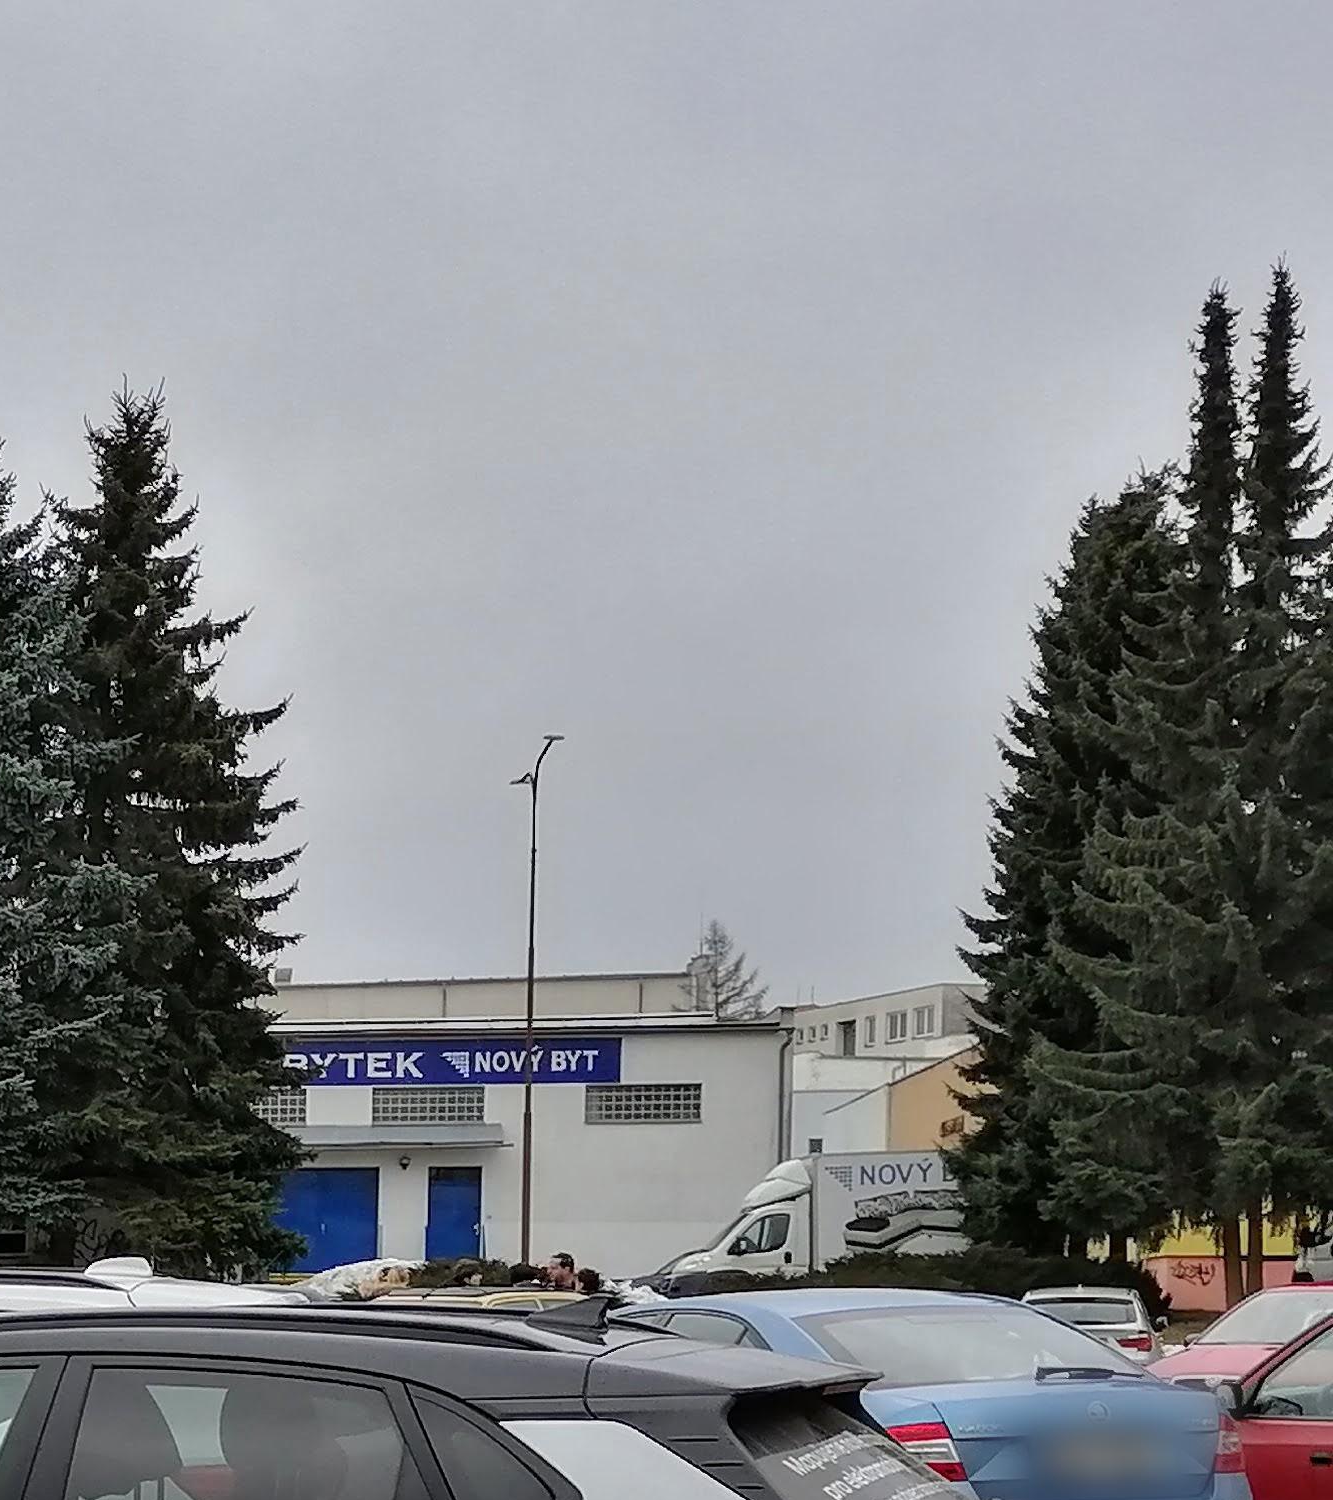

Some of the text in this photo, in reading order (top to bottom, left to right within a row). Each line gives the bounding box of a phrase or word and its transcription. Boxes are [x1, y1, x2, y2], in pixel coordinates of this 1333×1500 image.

[474, 1045, 542, 1073] NOVÝ
[550, 1050, 599, 1073] BYT
[860, 1158, 933, 1186] NOVÝ
